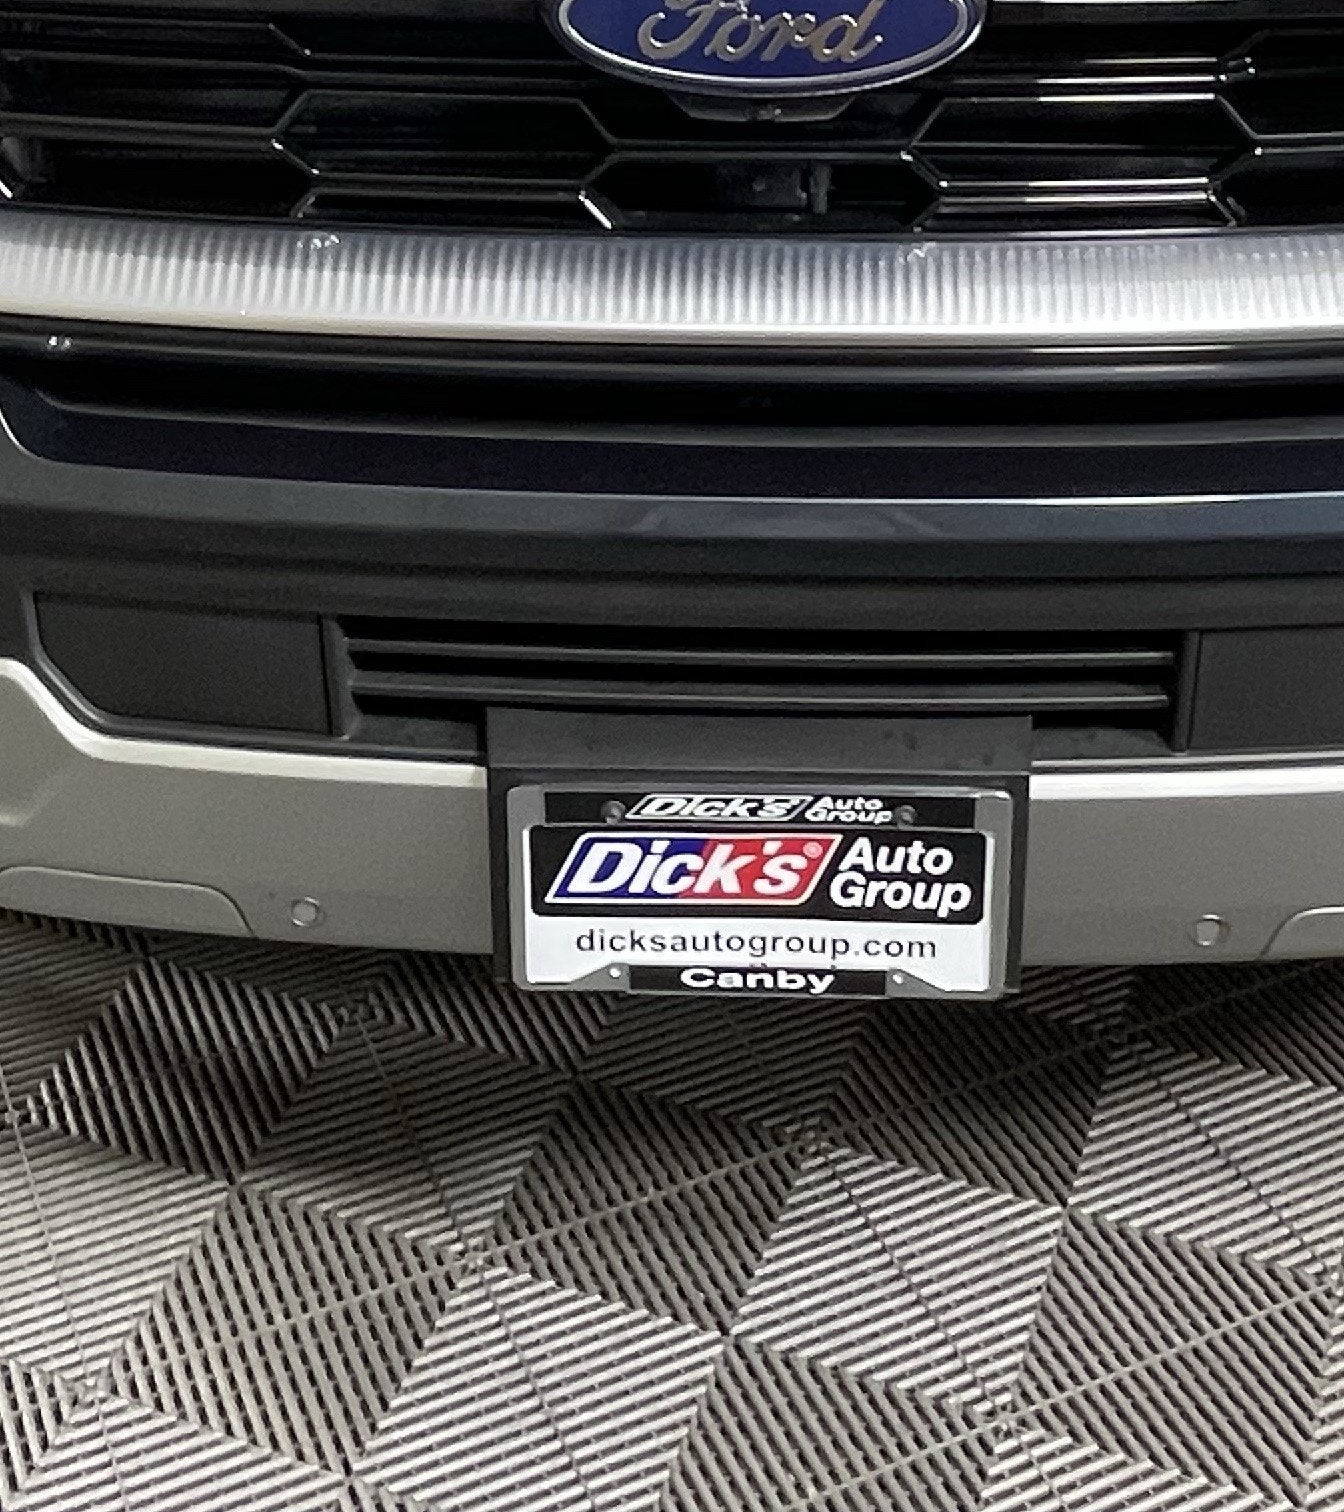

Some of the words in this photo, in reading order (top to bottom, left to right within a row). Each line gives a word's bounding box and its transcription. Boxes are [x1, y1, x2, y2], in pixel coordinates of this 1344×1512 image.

[812, 795, 883, 810] Auto
[804, 809, 894, 826] Group
[565, 839, 808, 896] Dick's
[838, 836, 955, 875] Auto
[828, 871, 973, 918] Group
[575, 928, 938, 960] dicksautogroup.com
[679, 967, 835, 994] Canby
